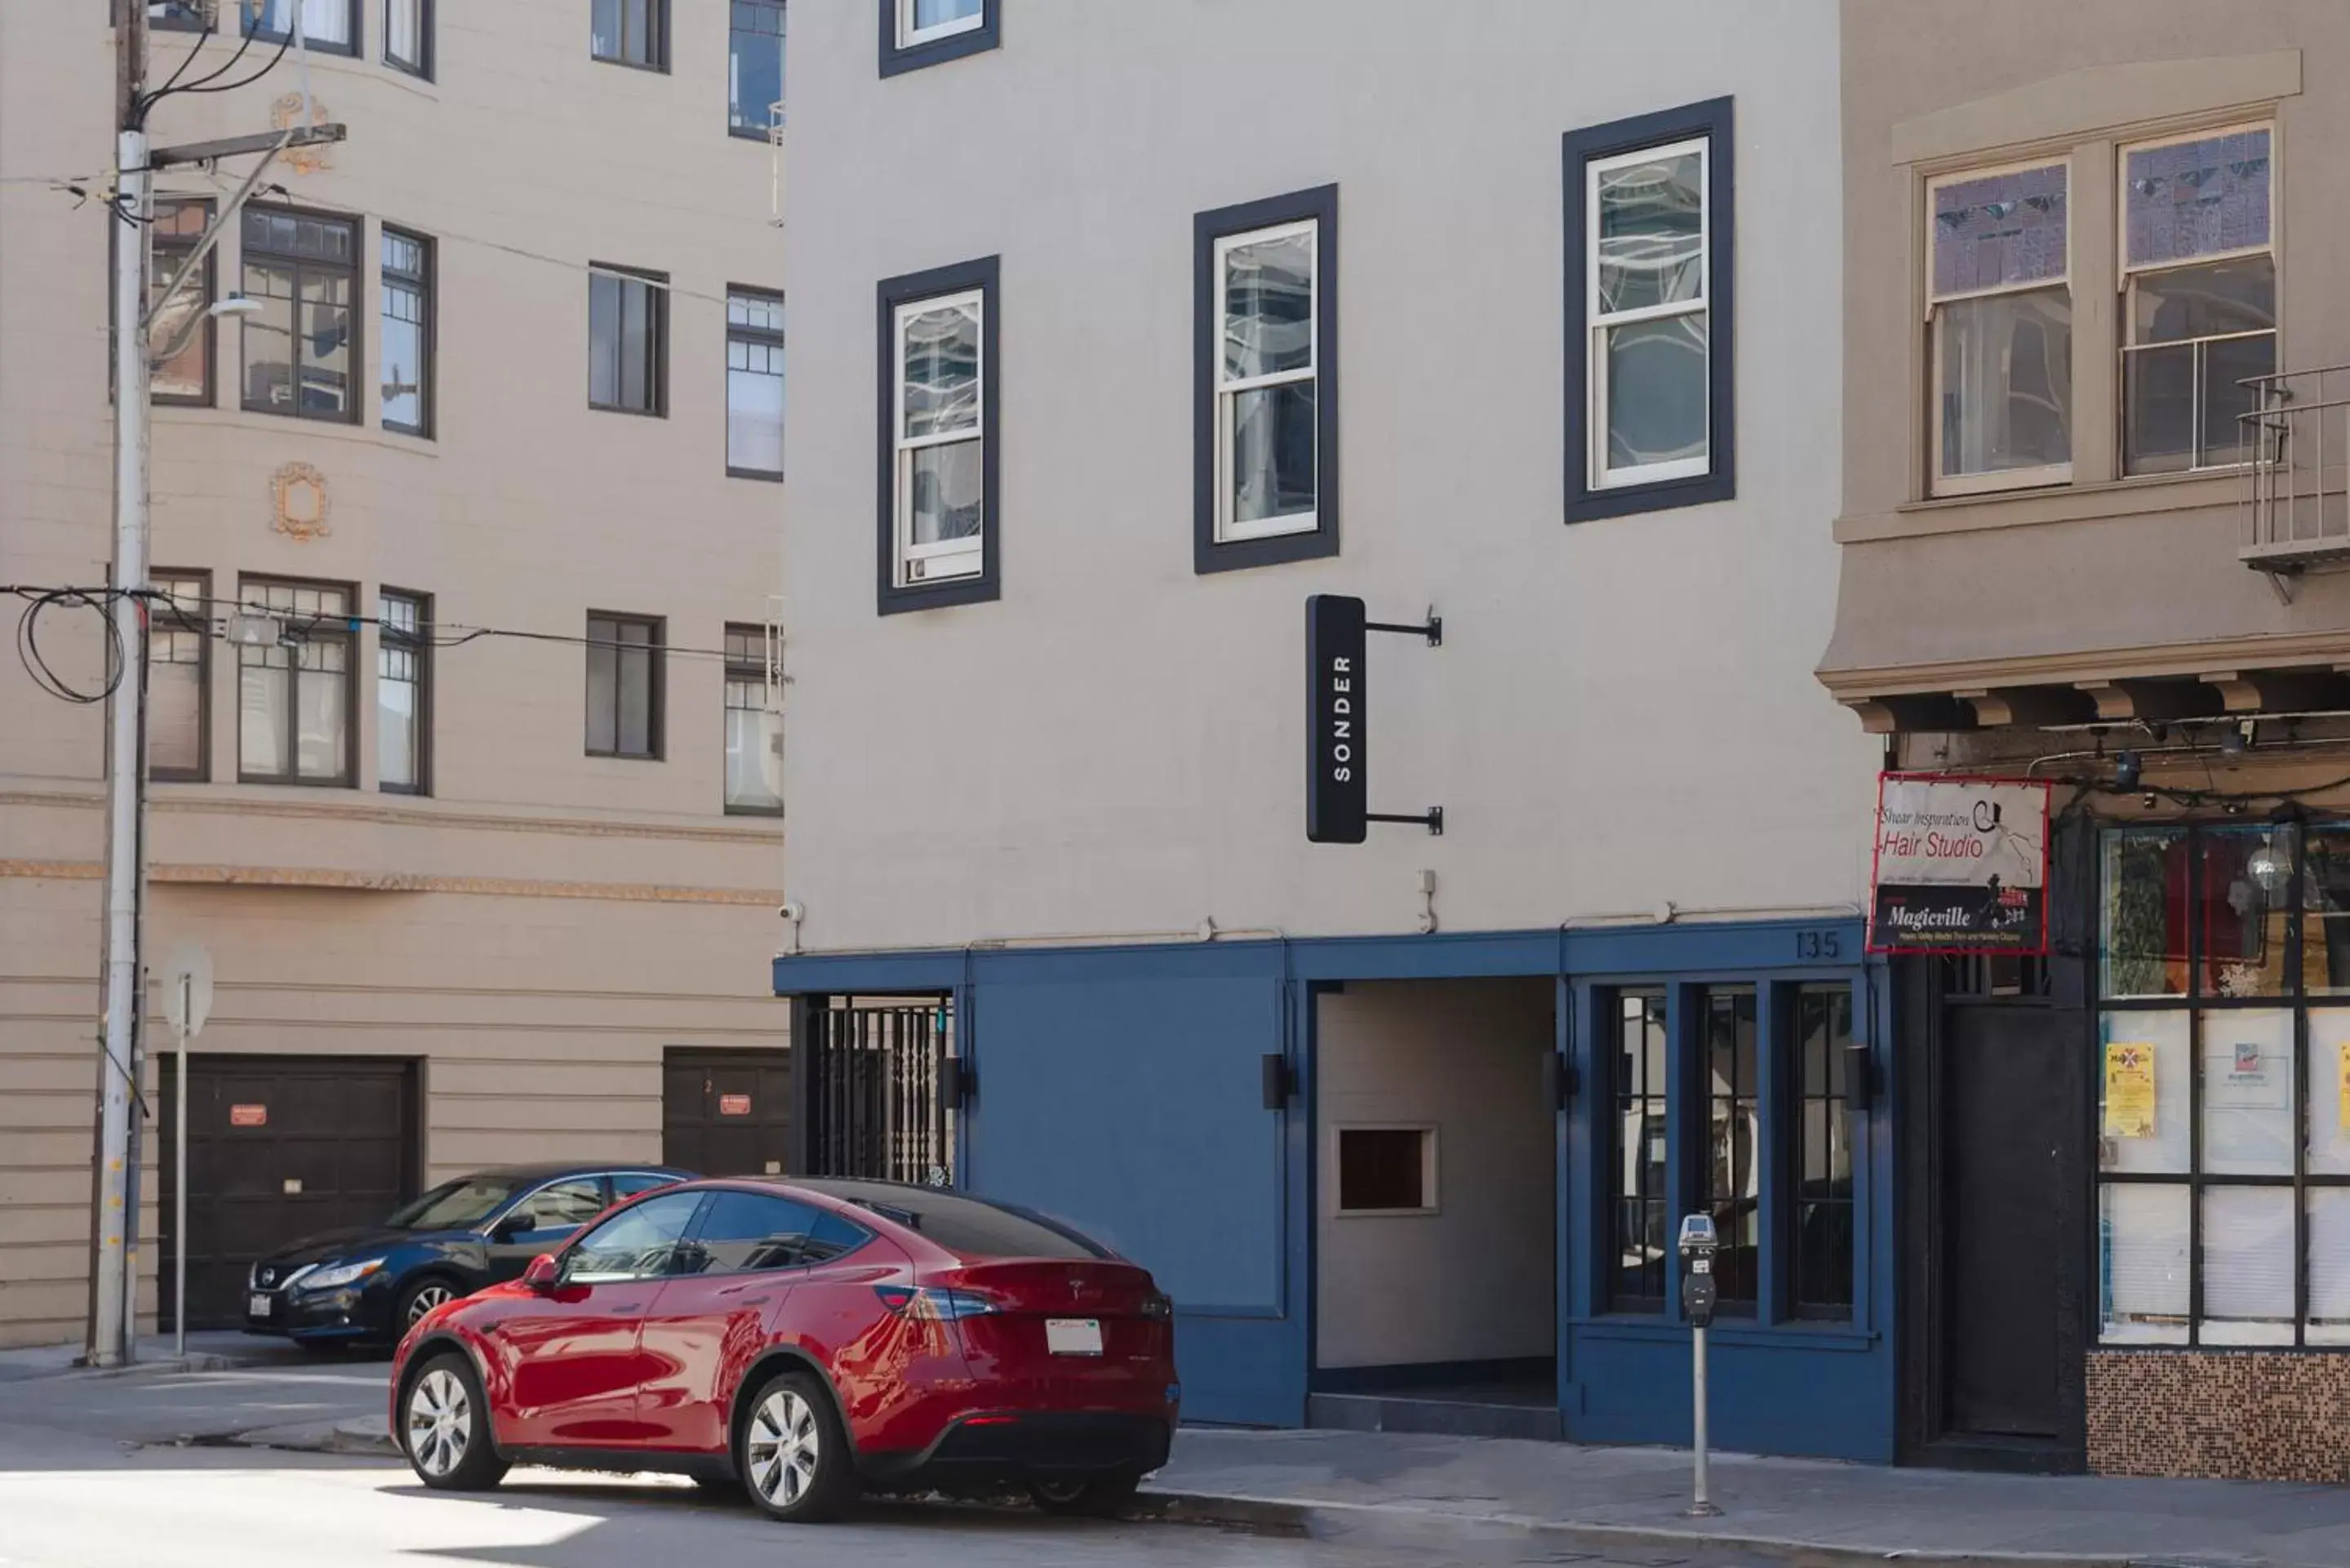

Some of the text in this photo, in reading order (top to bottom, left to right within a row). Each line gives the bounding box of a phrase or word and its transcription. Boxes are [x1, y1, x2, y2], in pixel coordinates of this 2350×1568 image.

[1334, 656, 1351, 782] SONDER
[1882, 830, 1984, 859] Hair Studio
[1887, 905, 1971, 931] Magicville
[1797, 931, 1838, 959] 135
